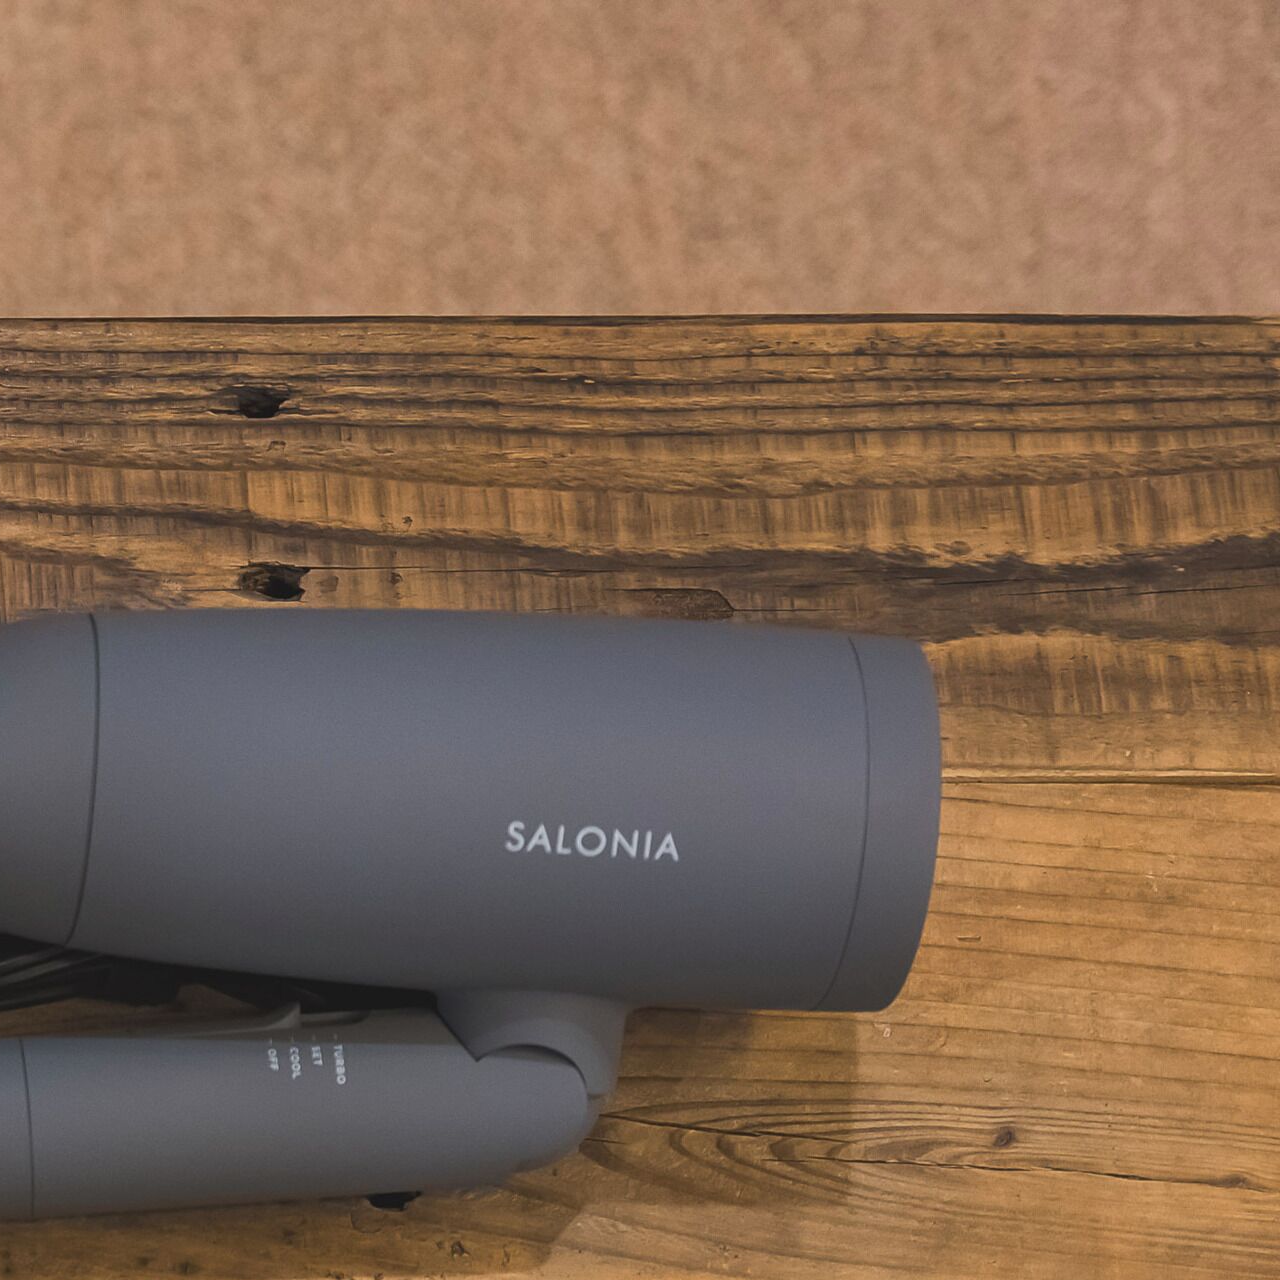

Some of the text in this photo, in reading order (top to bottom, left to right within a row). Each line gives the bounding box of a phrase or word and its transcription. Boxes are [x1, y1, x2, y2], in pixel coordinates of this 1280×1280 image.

[505, 820, 679, 862] SALONIA
[268, 1048, 279, 1072] OFF
[290, 1046, 301, 1080] COOL
[311, 1046, 323, 1067] SET
[334, 1044, 347, 1085] TURBO
